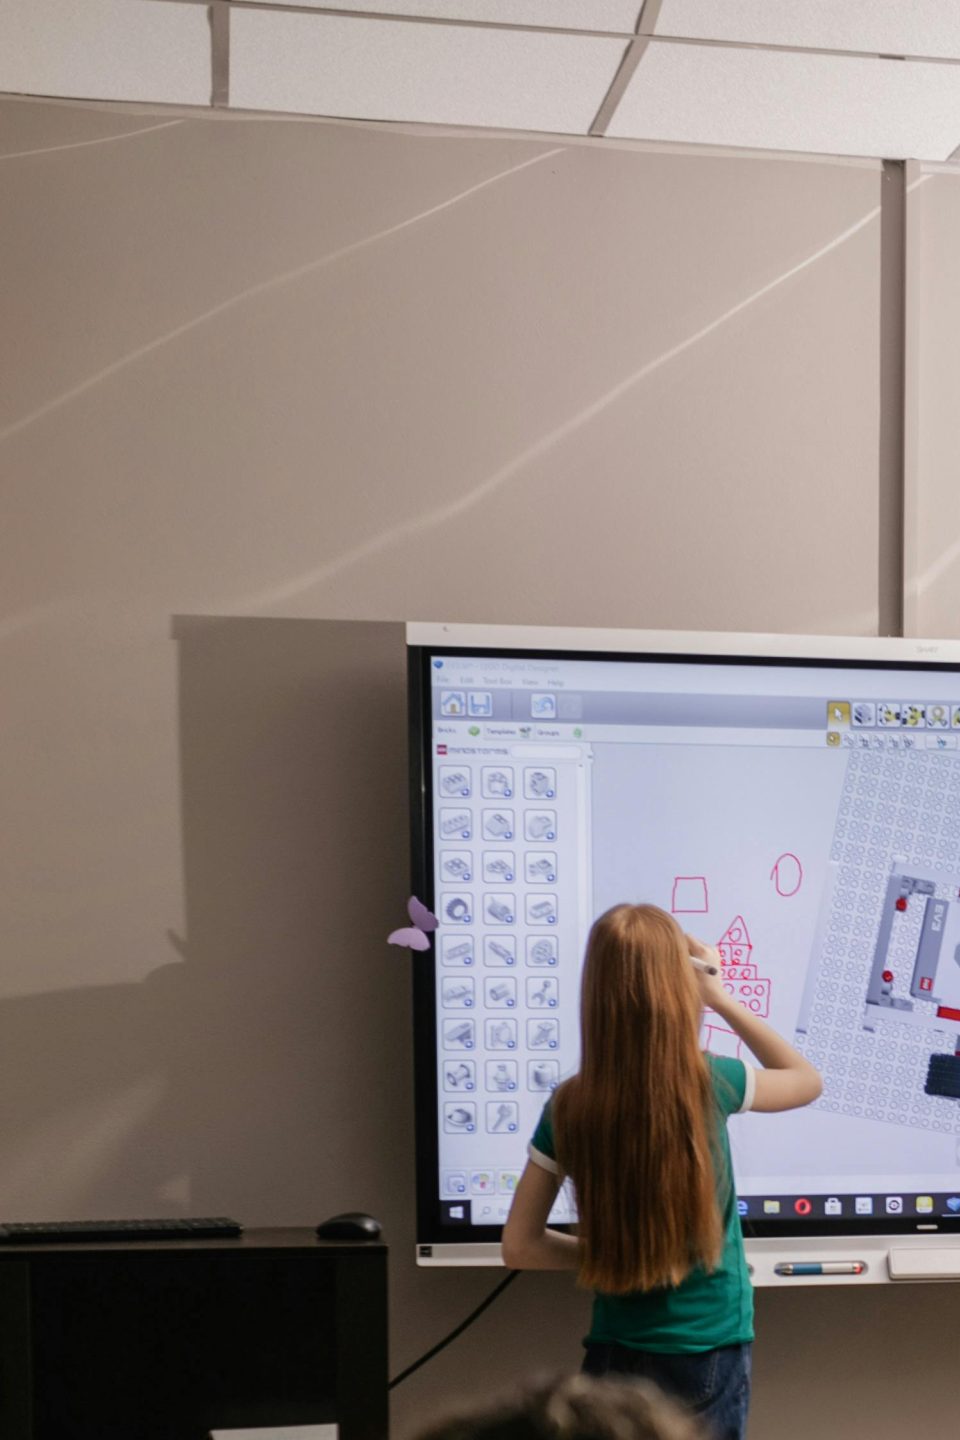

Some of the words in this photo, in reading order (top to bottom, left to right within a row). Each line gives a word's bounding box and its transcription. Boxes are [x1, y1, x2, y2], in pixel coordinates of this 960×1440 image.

[486, 727, 517, 736] Templates
[537, 728, 561, 737] Groups
[931, 904, 945, 932] EV3
